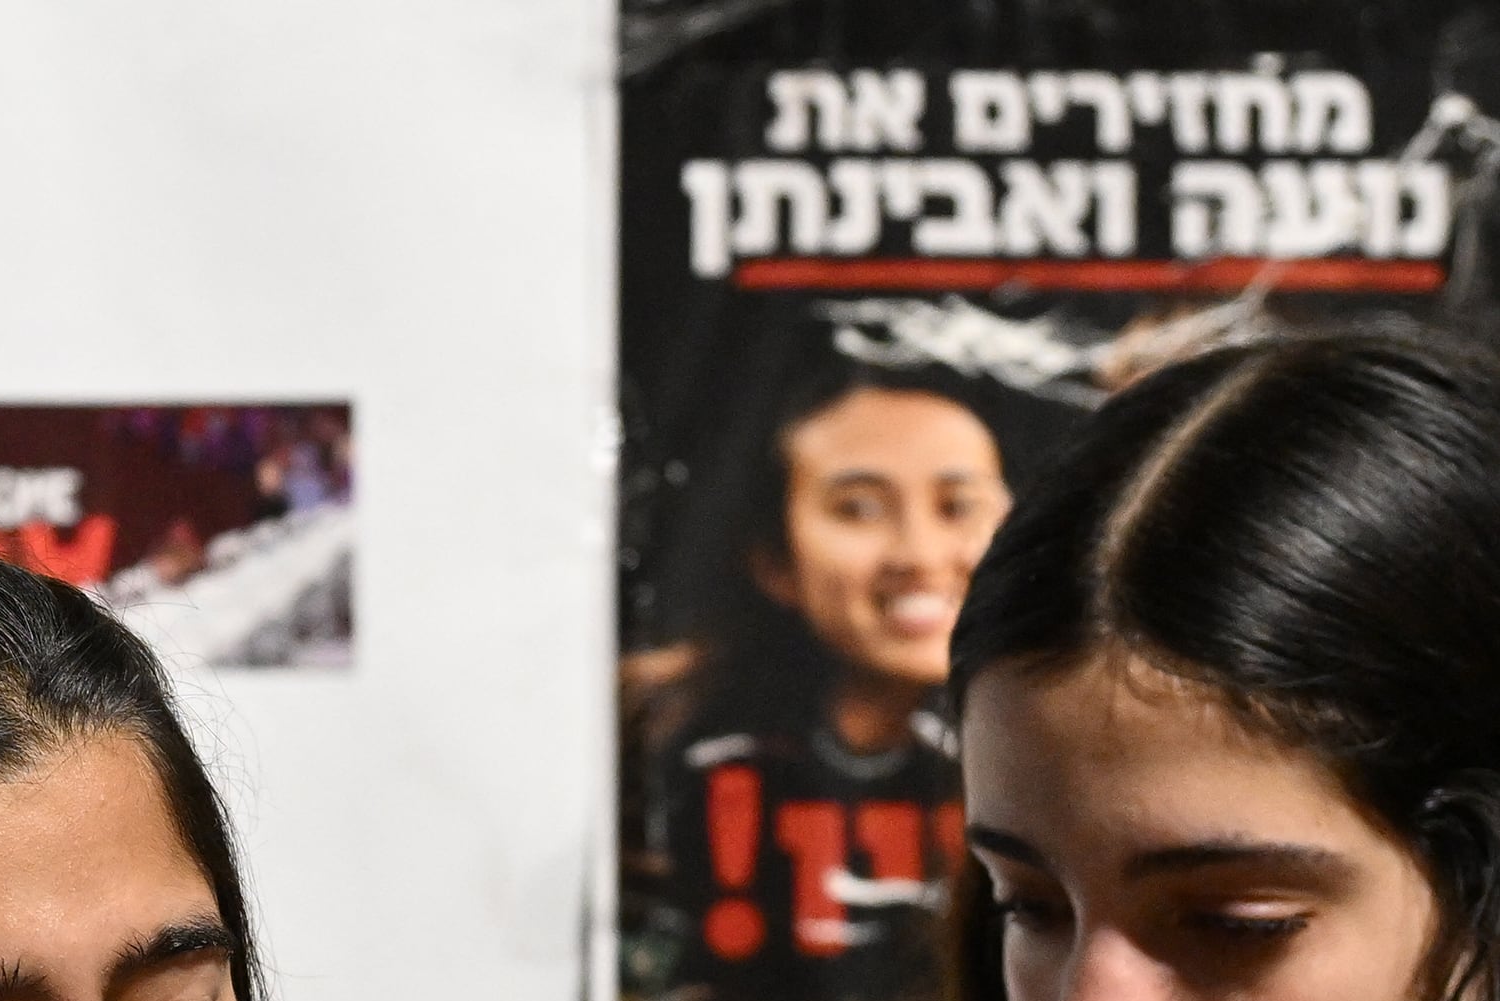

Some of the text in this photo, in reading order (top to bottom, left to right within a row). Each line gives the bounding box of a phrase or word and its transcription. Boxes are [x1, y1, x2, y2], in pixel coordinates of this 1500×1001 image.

[765, 68, 1372, 153] מחזירים את
[681, 158, 1451, 279] נועה ואבינתן
